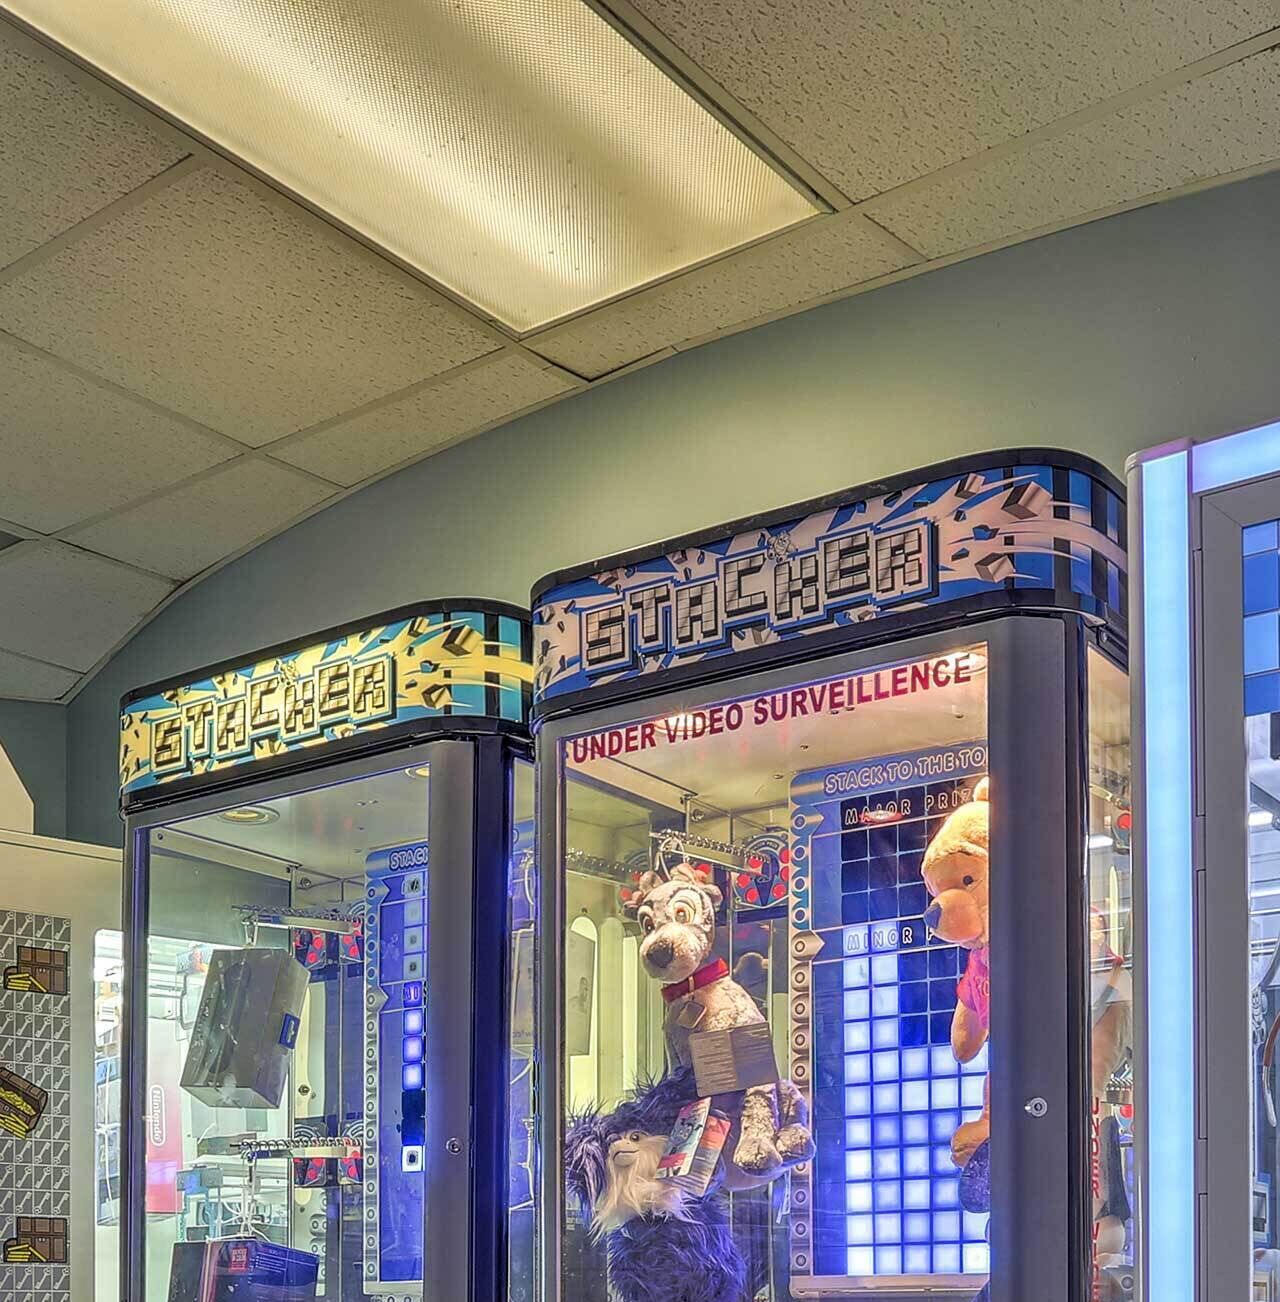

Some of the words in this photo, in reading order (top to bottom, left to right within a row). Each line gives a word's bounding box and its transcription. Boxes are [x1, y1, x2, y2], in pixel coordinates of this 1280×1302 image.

[585, 527, 924, 667] STACKER
[153, 662, 394, 768] STACKER
[572, 722, 656, 764] UNDER
[664, 705, 742, 744] VIDEO
[754, 653, 971, 725] SURVEILLENCE
[825, 765, 884, 794] STACK
[886, 762, 912, 781] TO
[918, 753, 955, 777] THE
[958, 746, 988, 768] TO
[847, 926, 913, 951] MINOR
[151, 1089, 164, 1144] Nintendo
